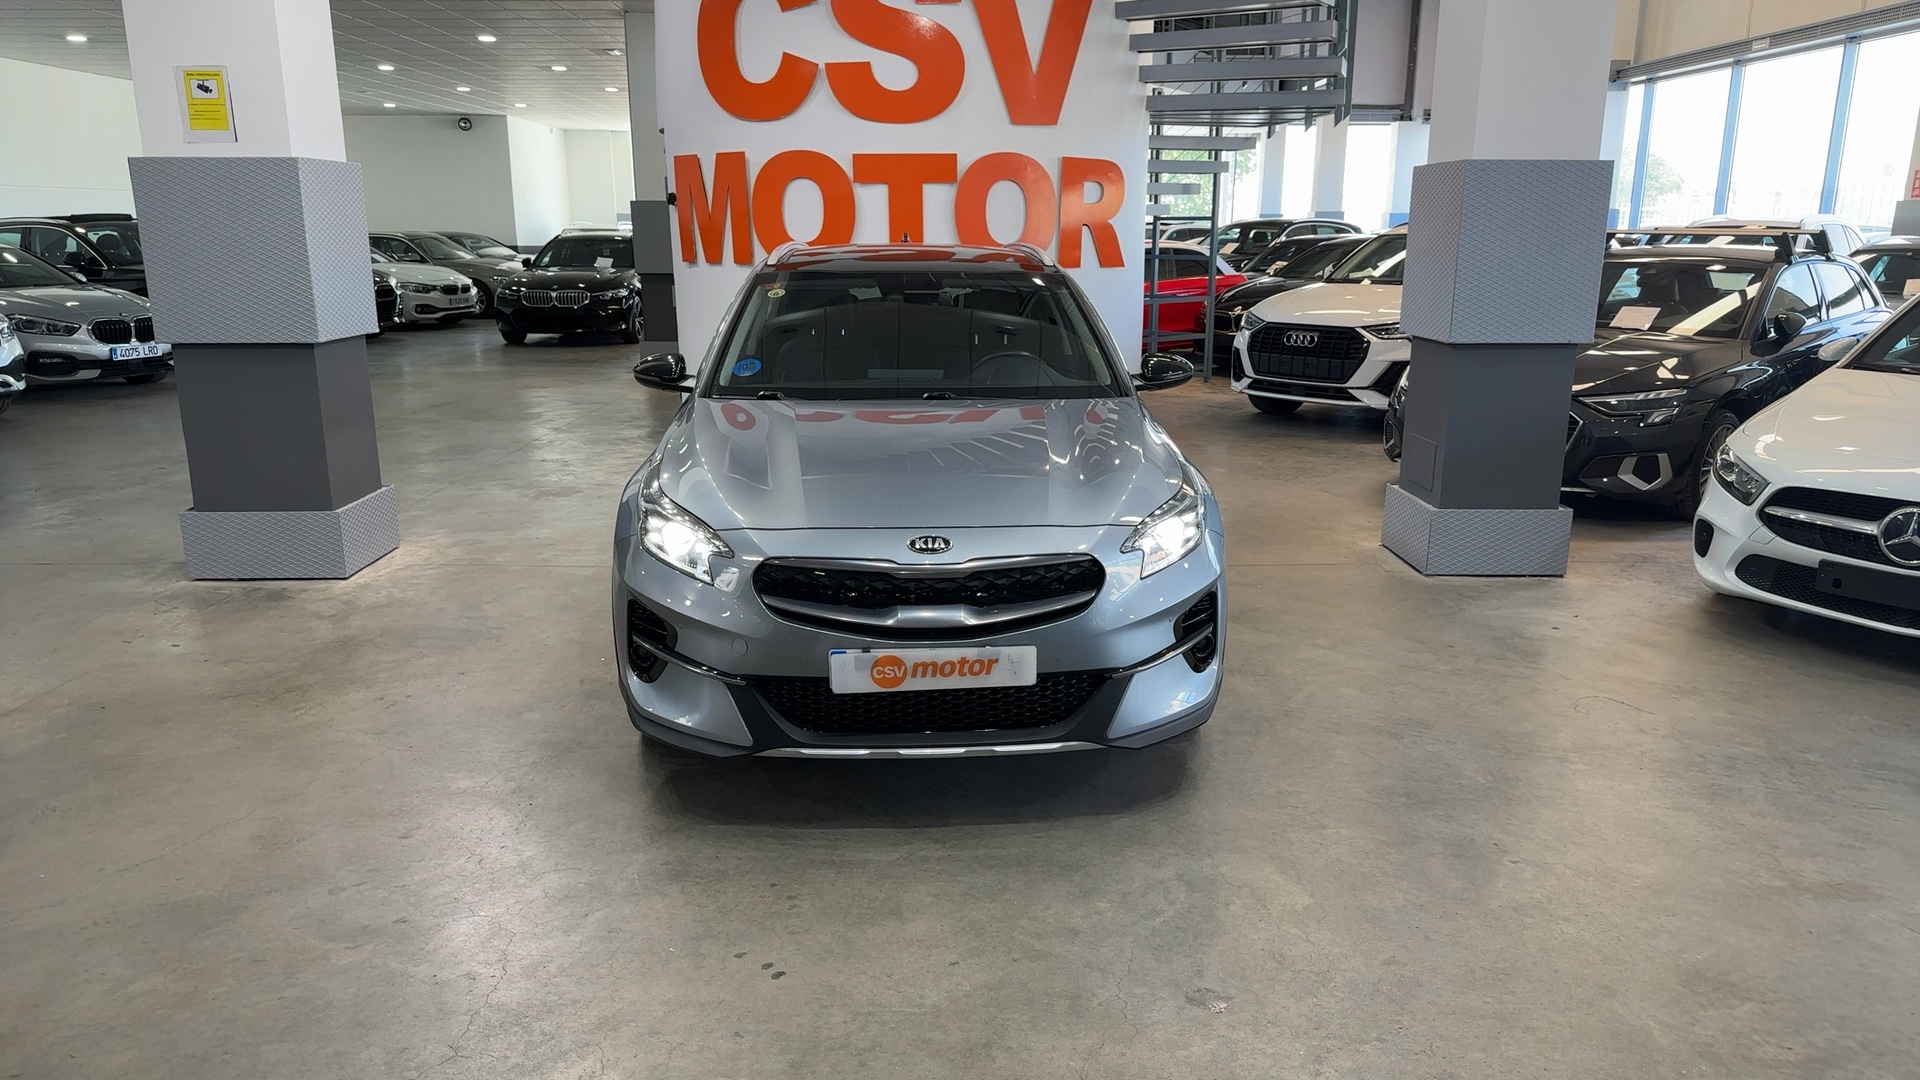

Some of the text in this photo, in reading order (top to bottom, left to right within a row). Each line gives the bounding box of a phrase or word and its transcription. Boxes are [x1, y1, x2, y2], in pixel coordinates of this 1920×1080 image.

[697, 0, 1092, 125] CSV
[674, 149, 1125, 268] MOTOR
[120, 345, 158, 358] 4075 LRD
[915, 537, 946, 549] KIA
[910, 656, 999, 679] motor
